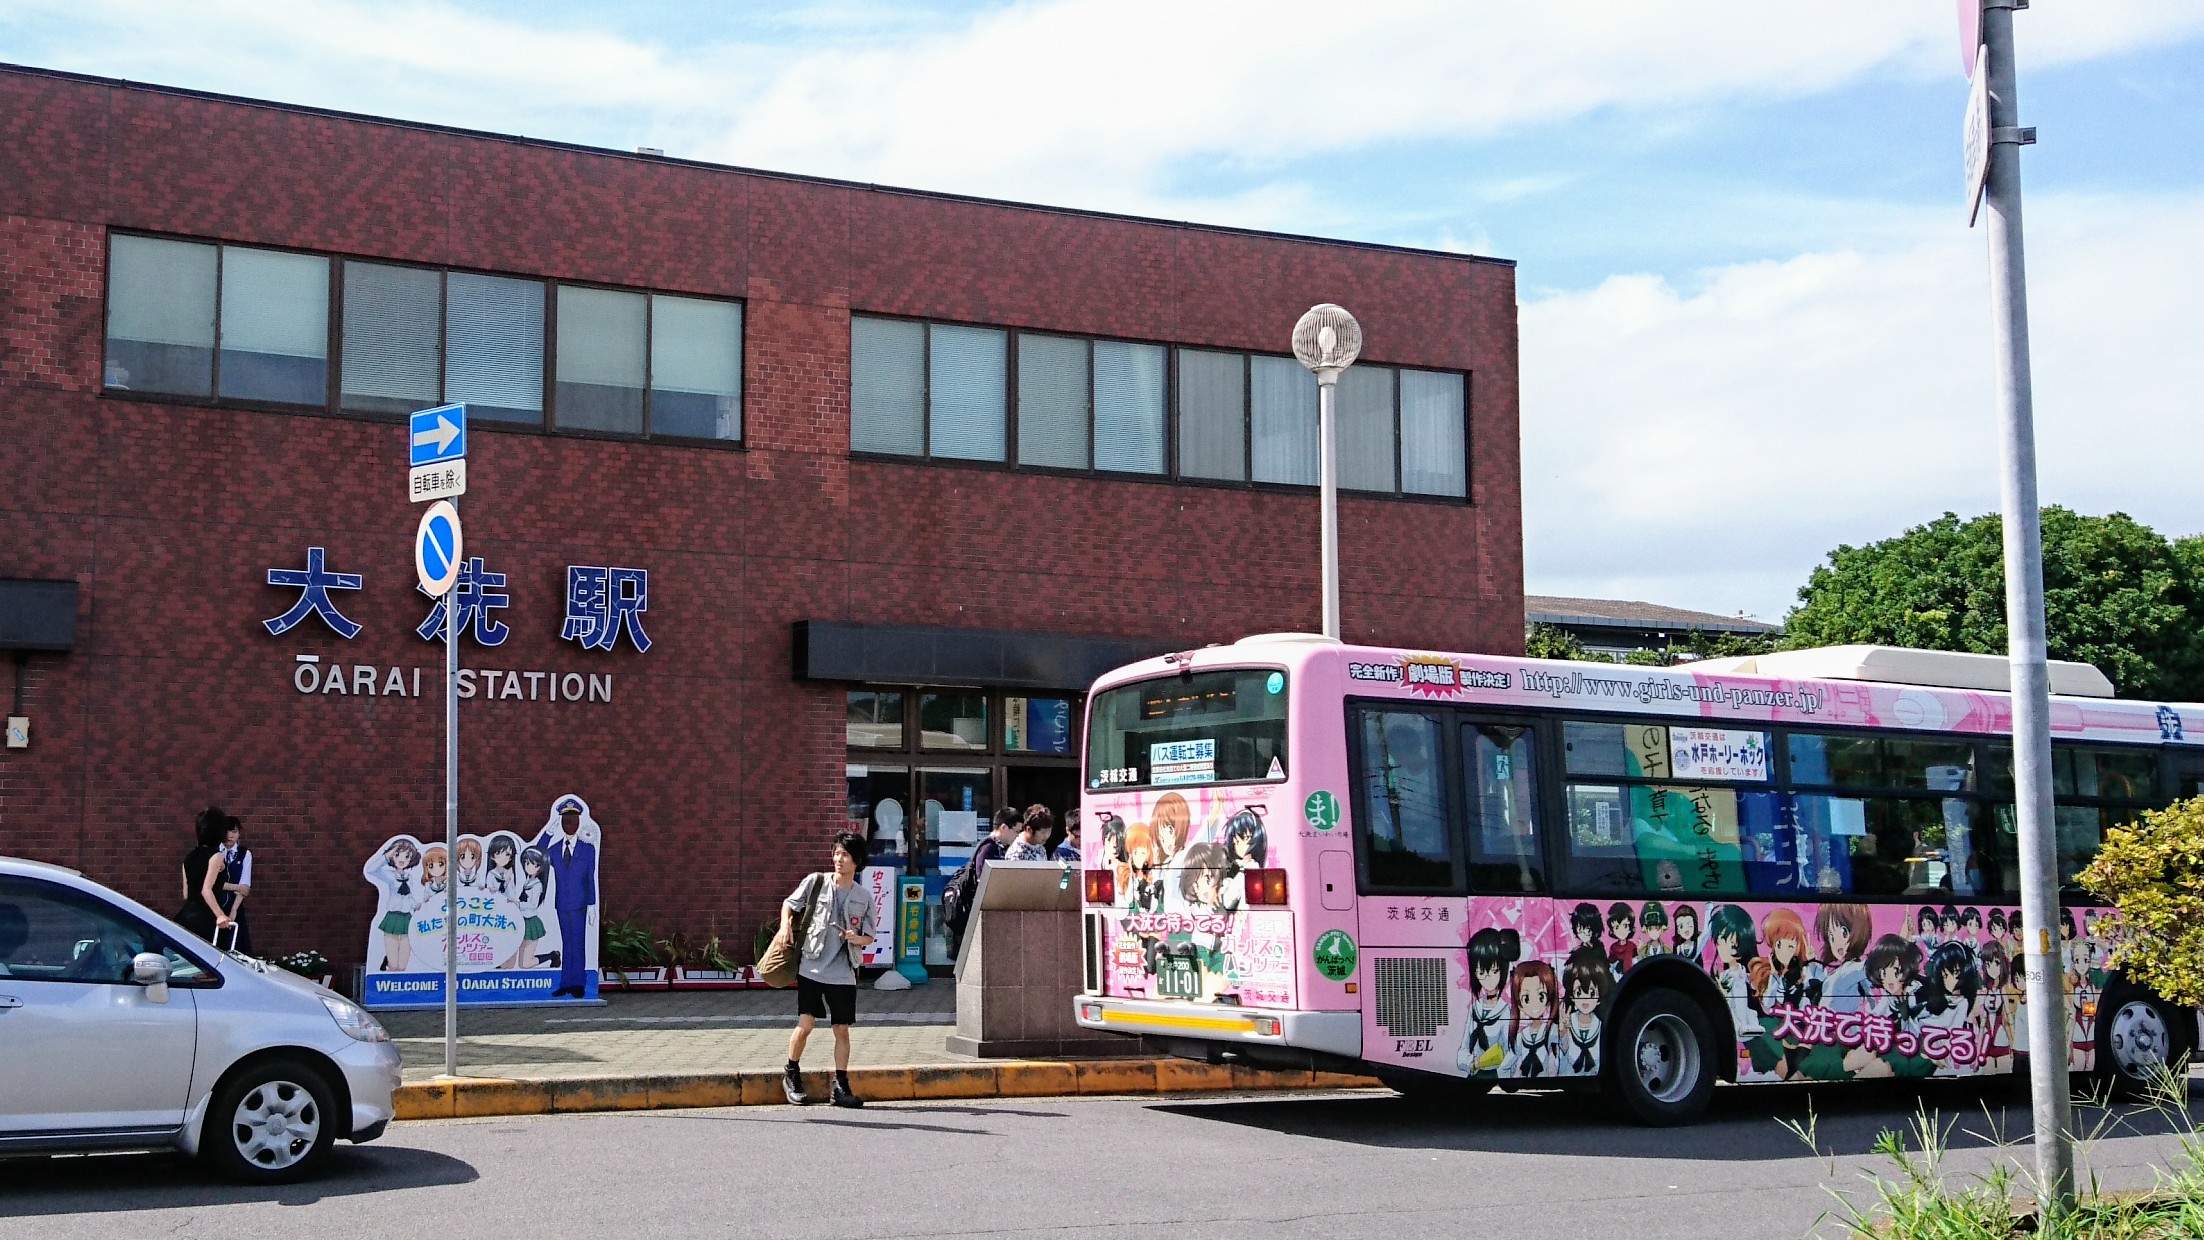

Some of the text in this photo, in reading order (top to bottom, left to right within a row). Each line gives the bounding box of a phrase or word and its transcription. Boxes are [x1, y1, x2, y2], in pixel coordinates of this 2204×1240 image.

[413, 469, 461, 494] 自転車を除く
[1350, 663, 1404, 681] 完全新作!
[1407, 663, 1454, 685] 劇場版
[1460, 670, 1512, 688] 製作決定!
[456, 668, 612, 702] STATION
[1520, 669, 1823, 714] http://www.girls-und-panzer.jp/
[1690, 731, 1726, 742] 茨城交通は
[1152, 742, 1213, 761] バス運転士募集
[1691, 743, 1764, 766] 水戸ホーリーホック
[1100, 767, 1138, 784] 茨城交通
[1126, 912, 1235, 934] 大洗で待ってる!
[1387, 906, 1450, 921] 茨城交通
[417, 914, 517, 933] 私たの町大洗へ
[376, 980, 438, 992] WELCOME
[462, 978, 498, 990] OARAI
[502, 978, 552, 989] STATION
[1773, 1004, 1993, 1065] 大洗で待ってる!
[1395, 1039, 1433, 1052] FEEL
